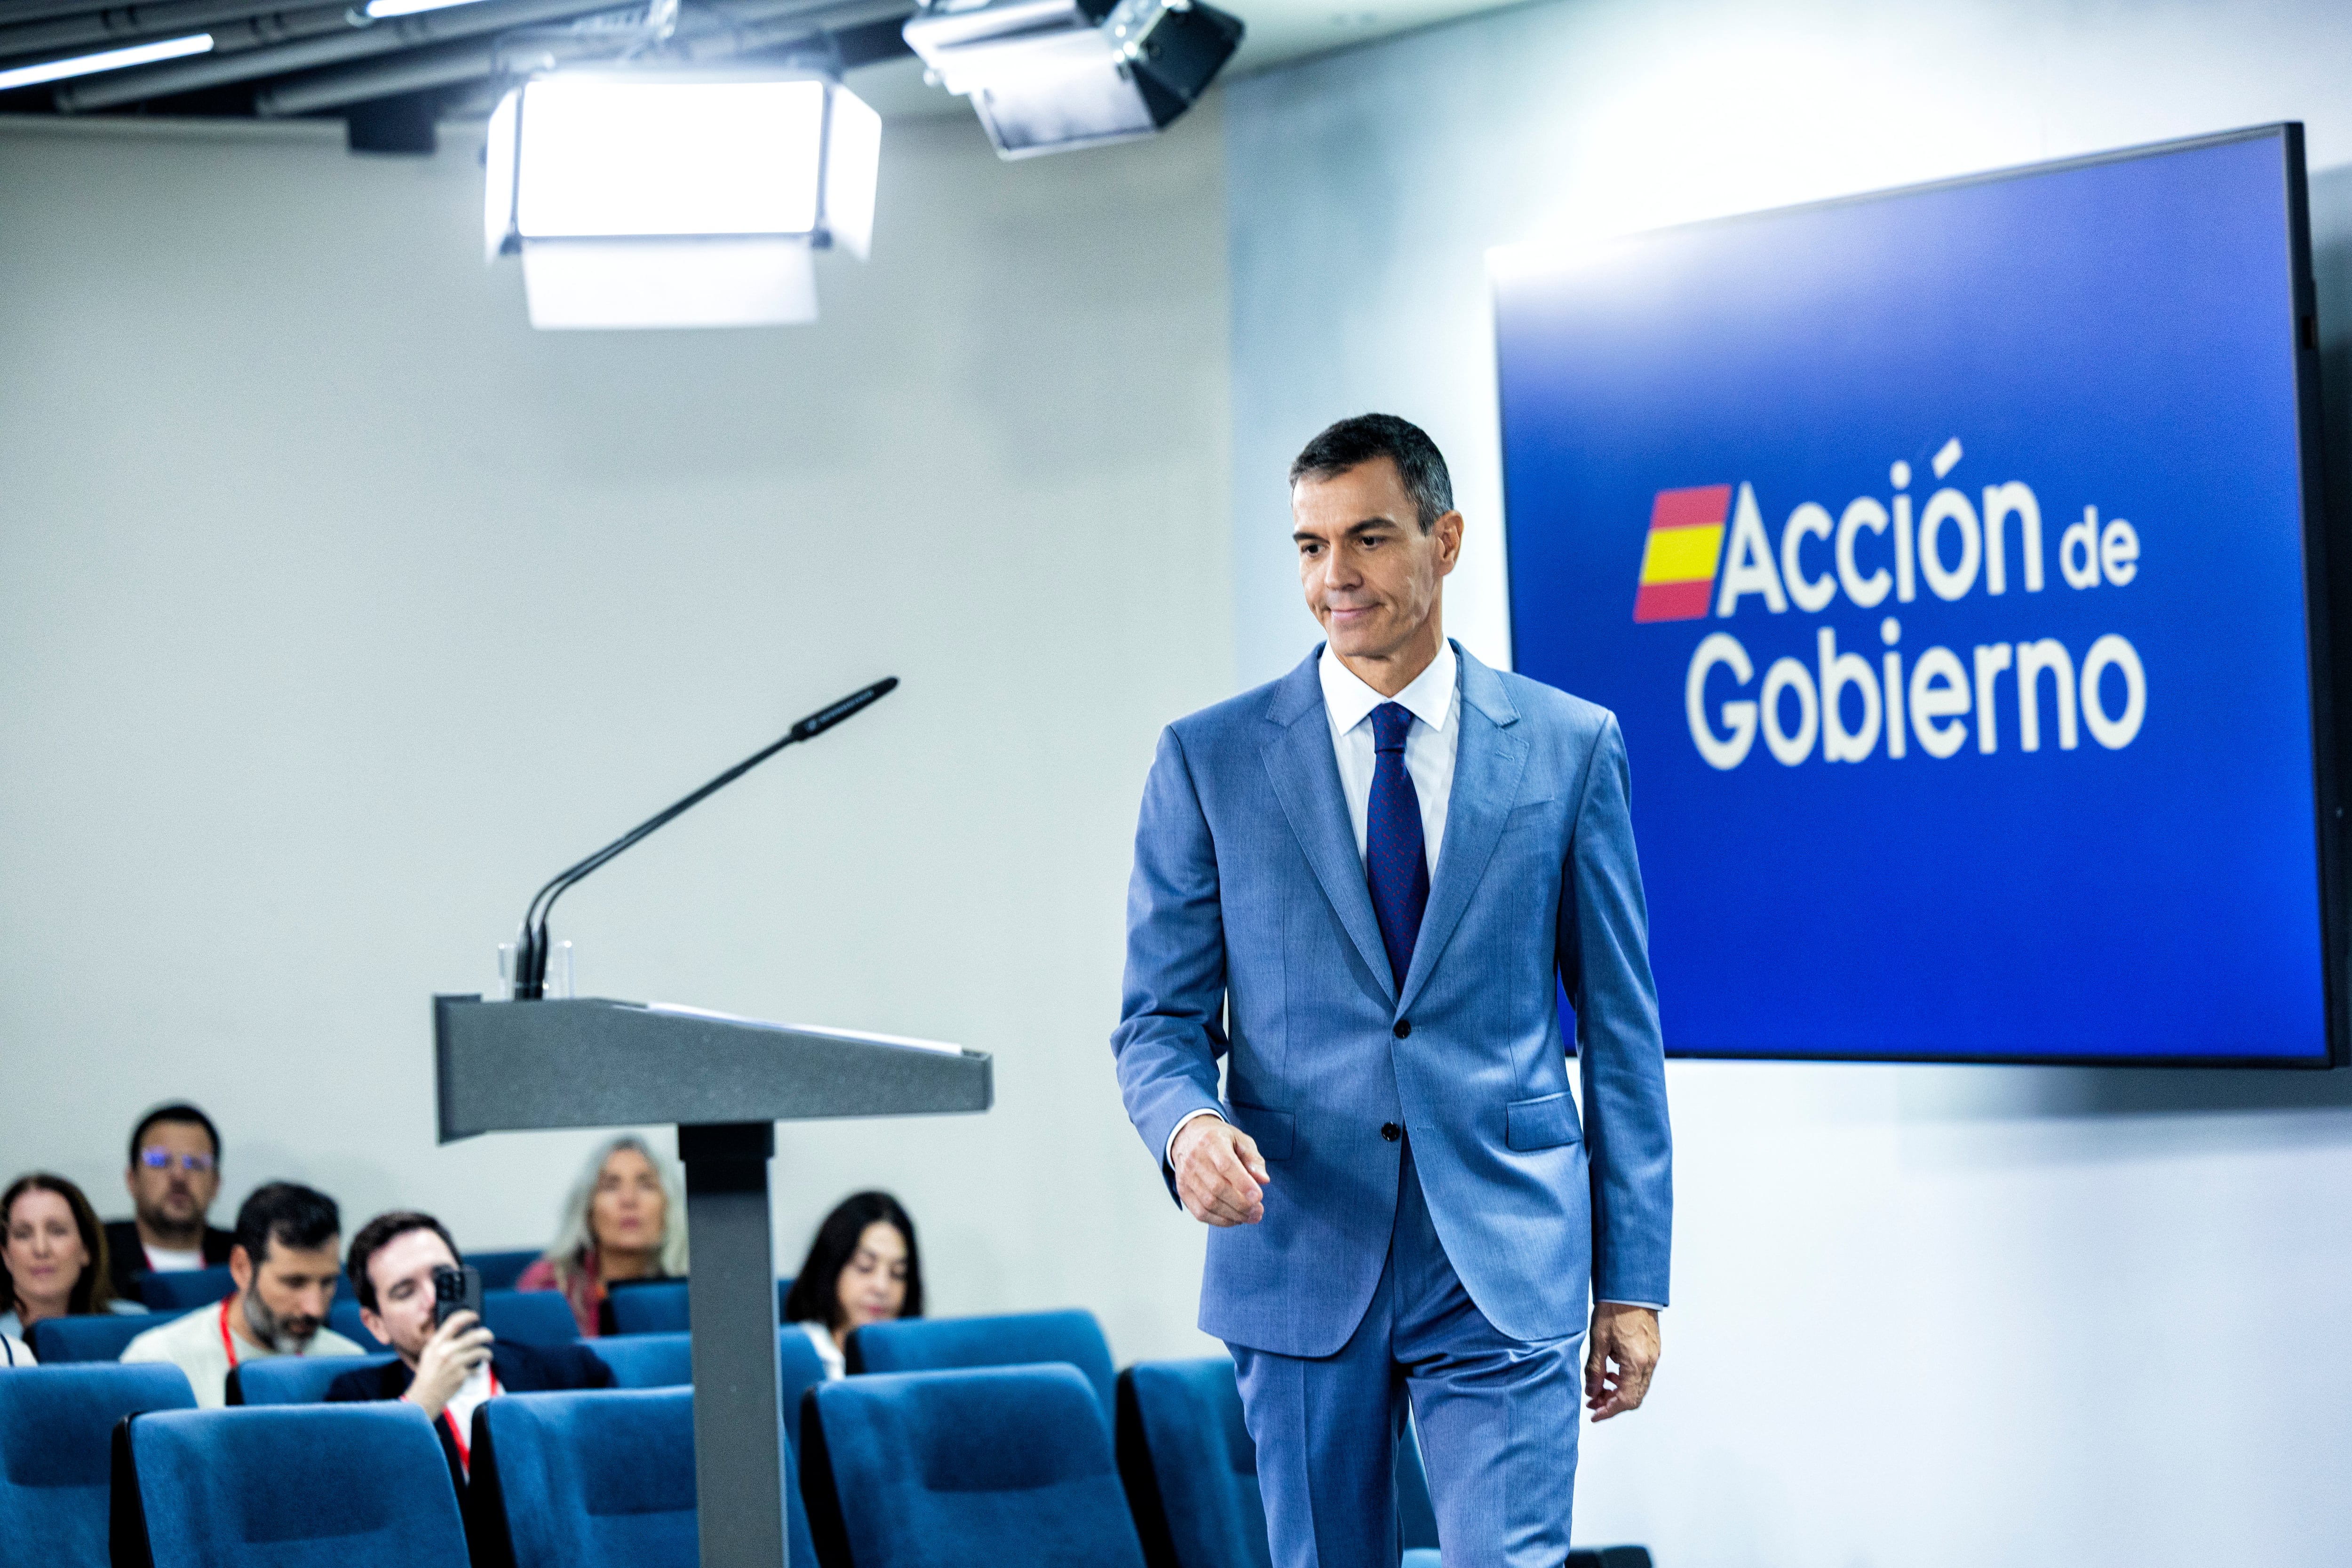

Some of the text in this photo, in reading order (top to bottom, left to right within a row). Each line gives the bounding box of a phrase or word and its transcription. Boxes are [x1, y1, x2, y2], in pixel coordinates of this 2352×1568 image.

[1717, 438, 2139, 617] Acción de
[1686, 618, 2146, 770] Gobierno
